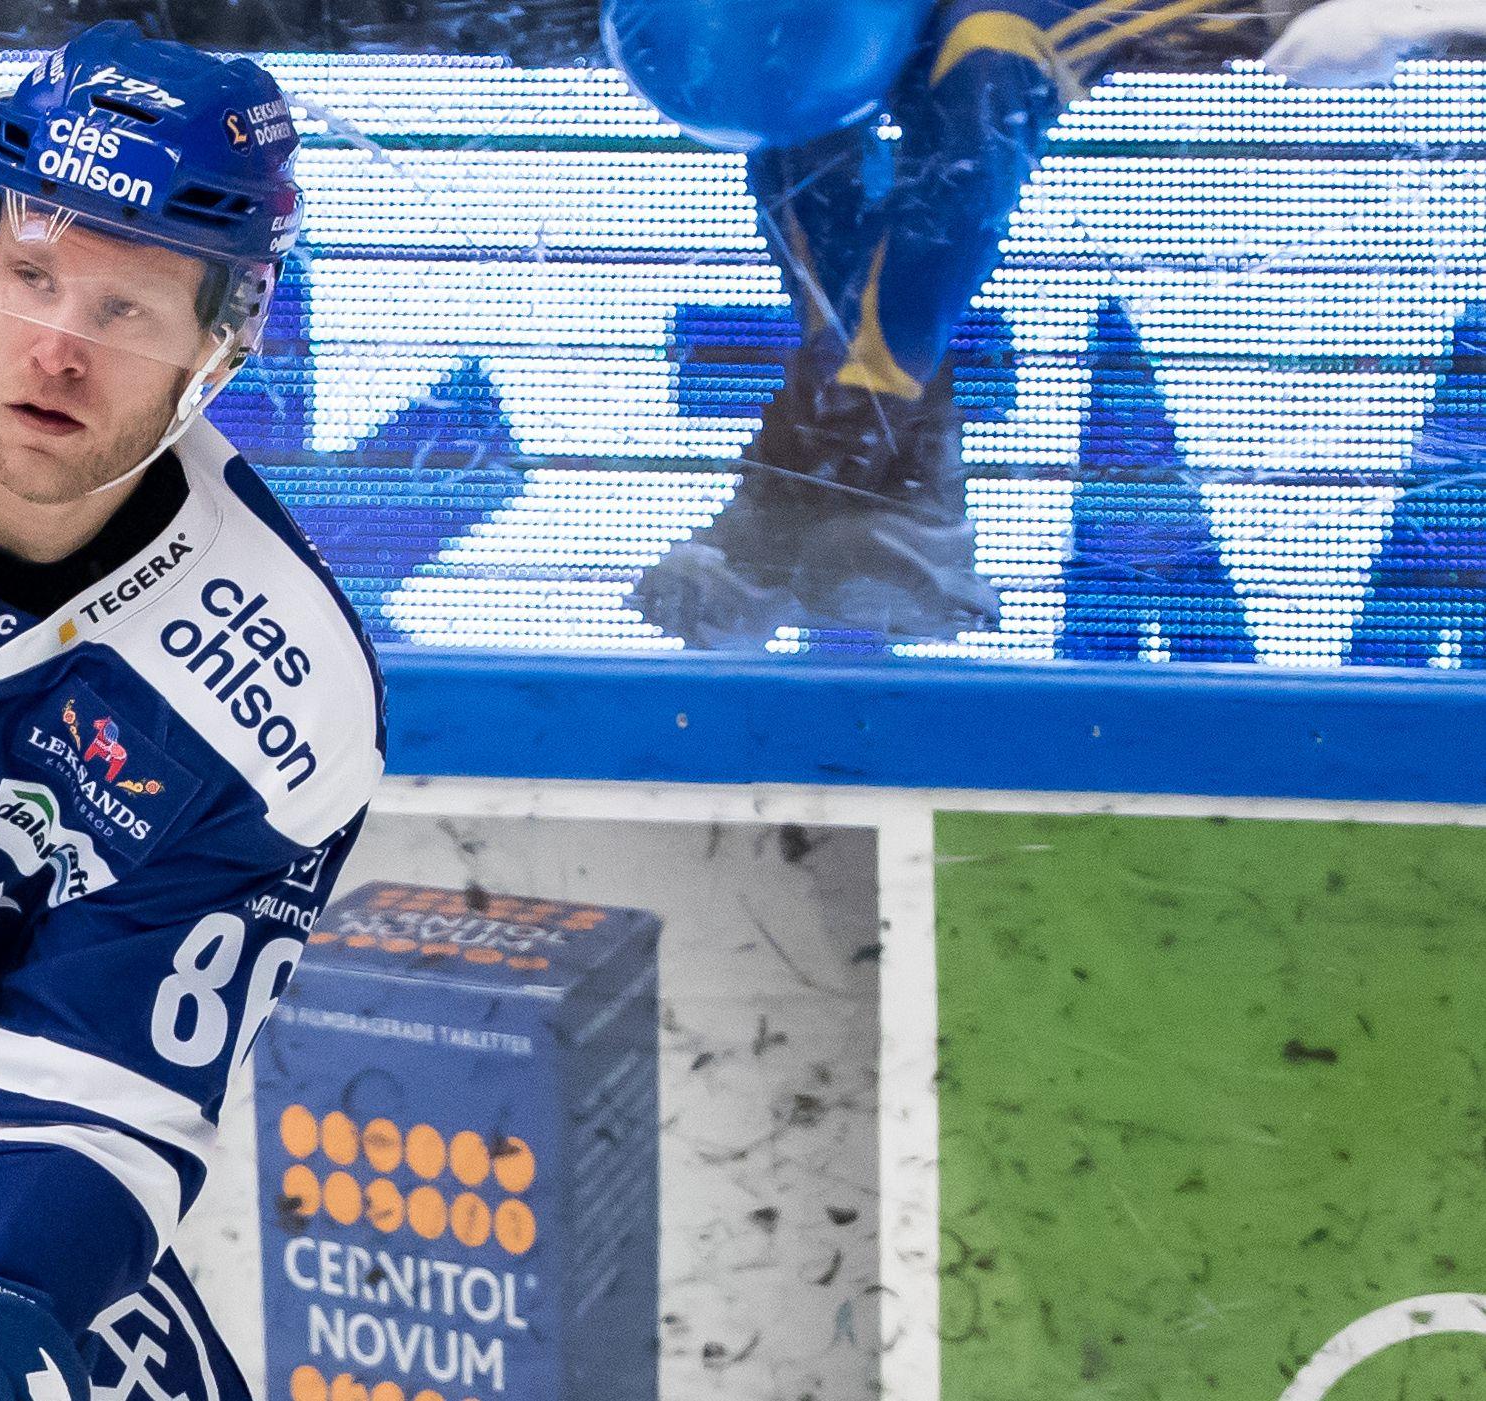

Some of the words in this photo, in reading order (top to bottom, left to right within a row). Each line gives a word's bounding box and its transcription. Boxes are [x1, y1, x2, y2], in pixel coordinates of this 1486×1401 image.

[38, 150, 153, 206] ohlson
[49, 116, 120, 159] clas
[201, 578, 310, 687] clas
[160, 619, 317, 793] ohlson
[28, 726, 153, 841] LEKSANDS
[308, 1304, 505, 1391] NOVUM
